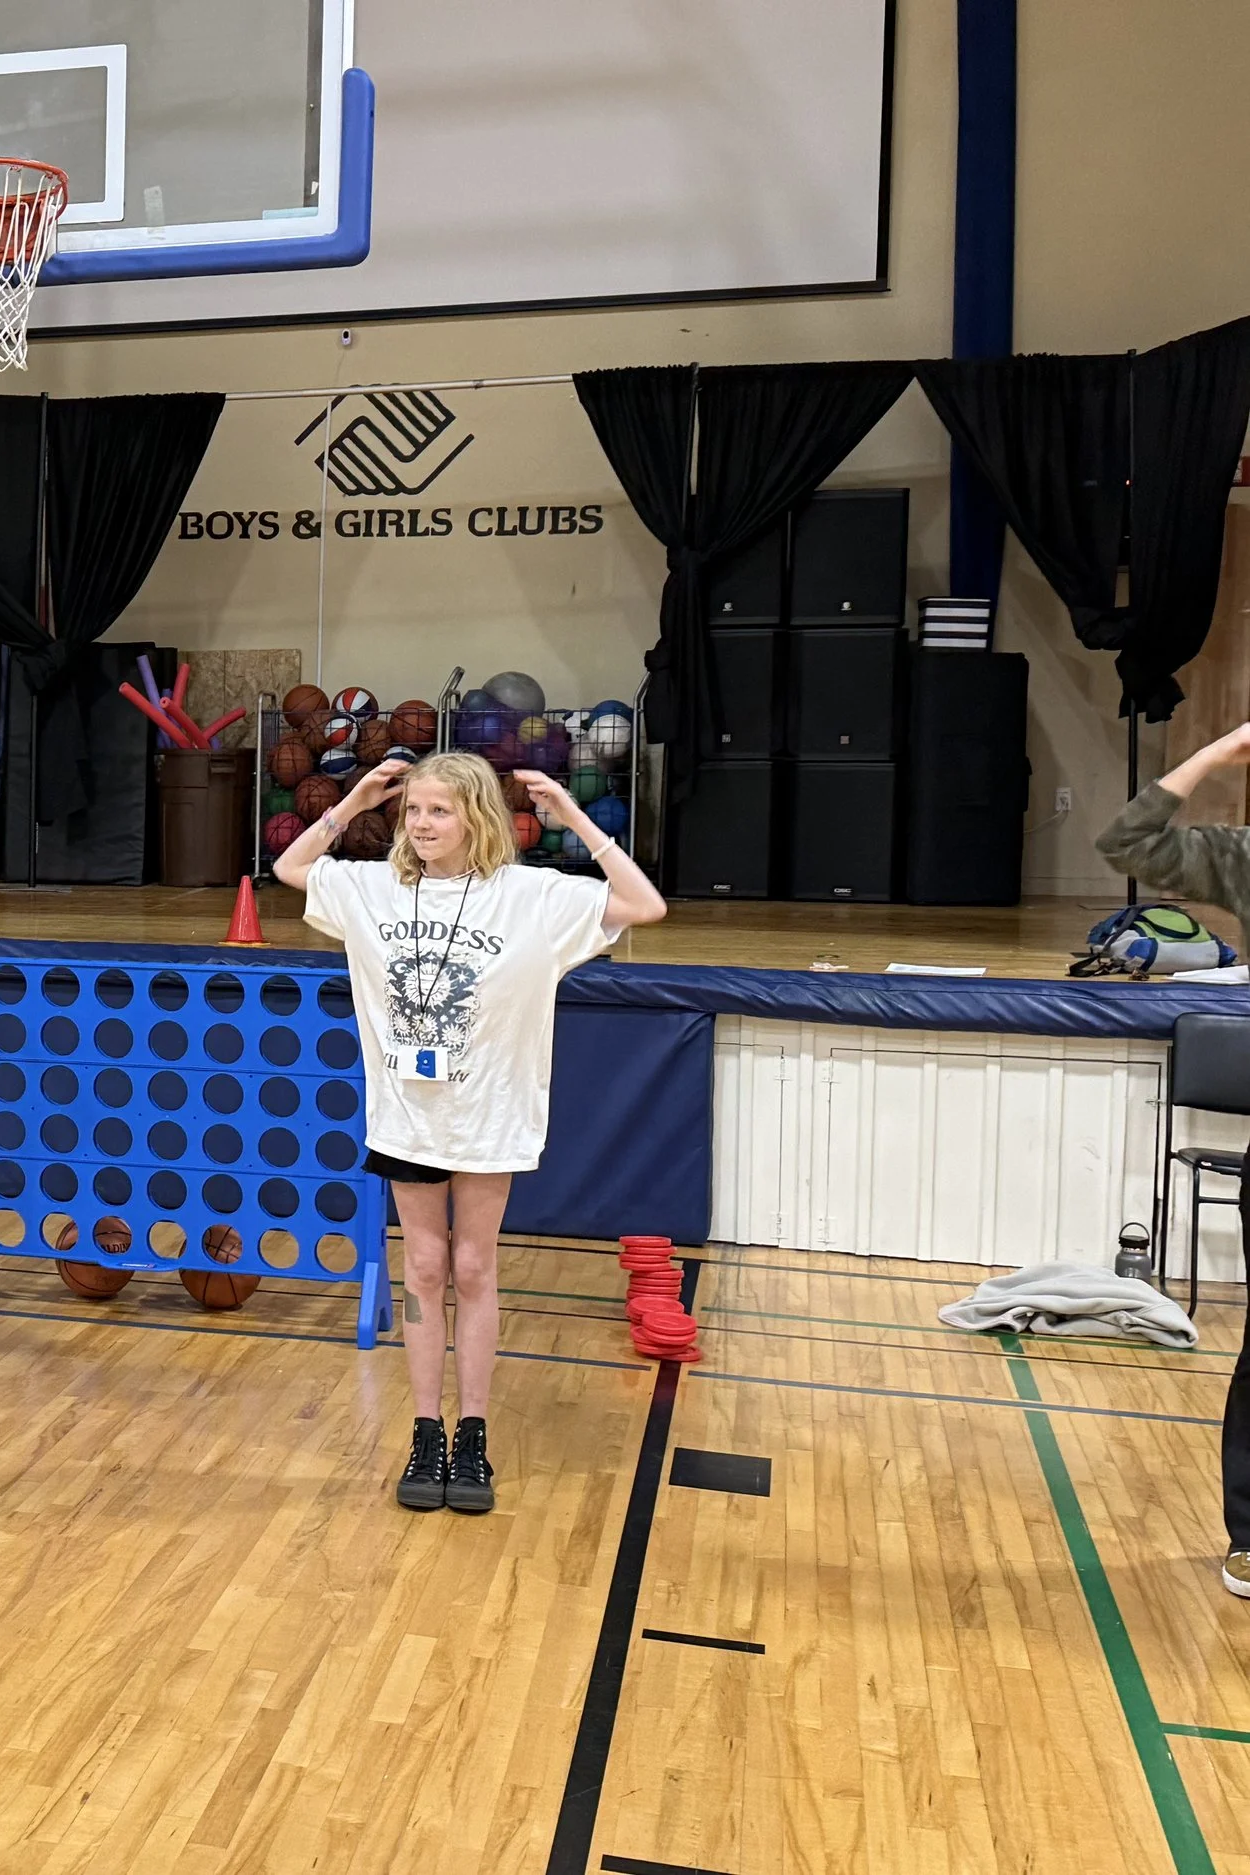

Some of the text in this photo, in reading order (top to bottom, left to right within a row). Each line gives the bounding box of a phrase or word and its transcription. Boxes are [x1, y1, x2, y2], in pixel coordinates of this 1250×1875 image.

[179, 504, 604, 540] BOYS & GIRLS CLUBS
[379, 920, 504, 955] GODDESS
